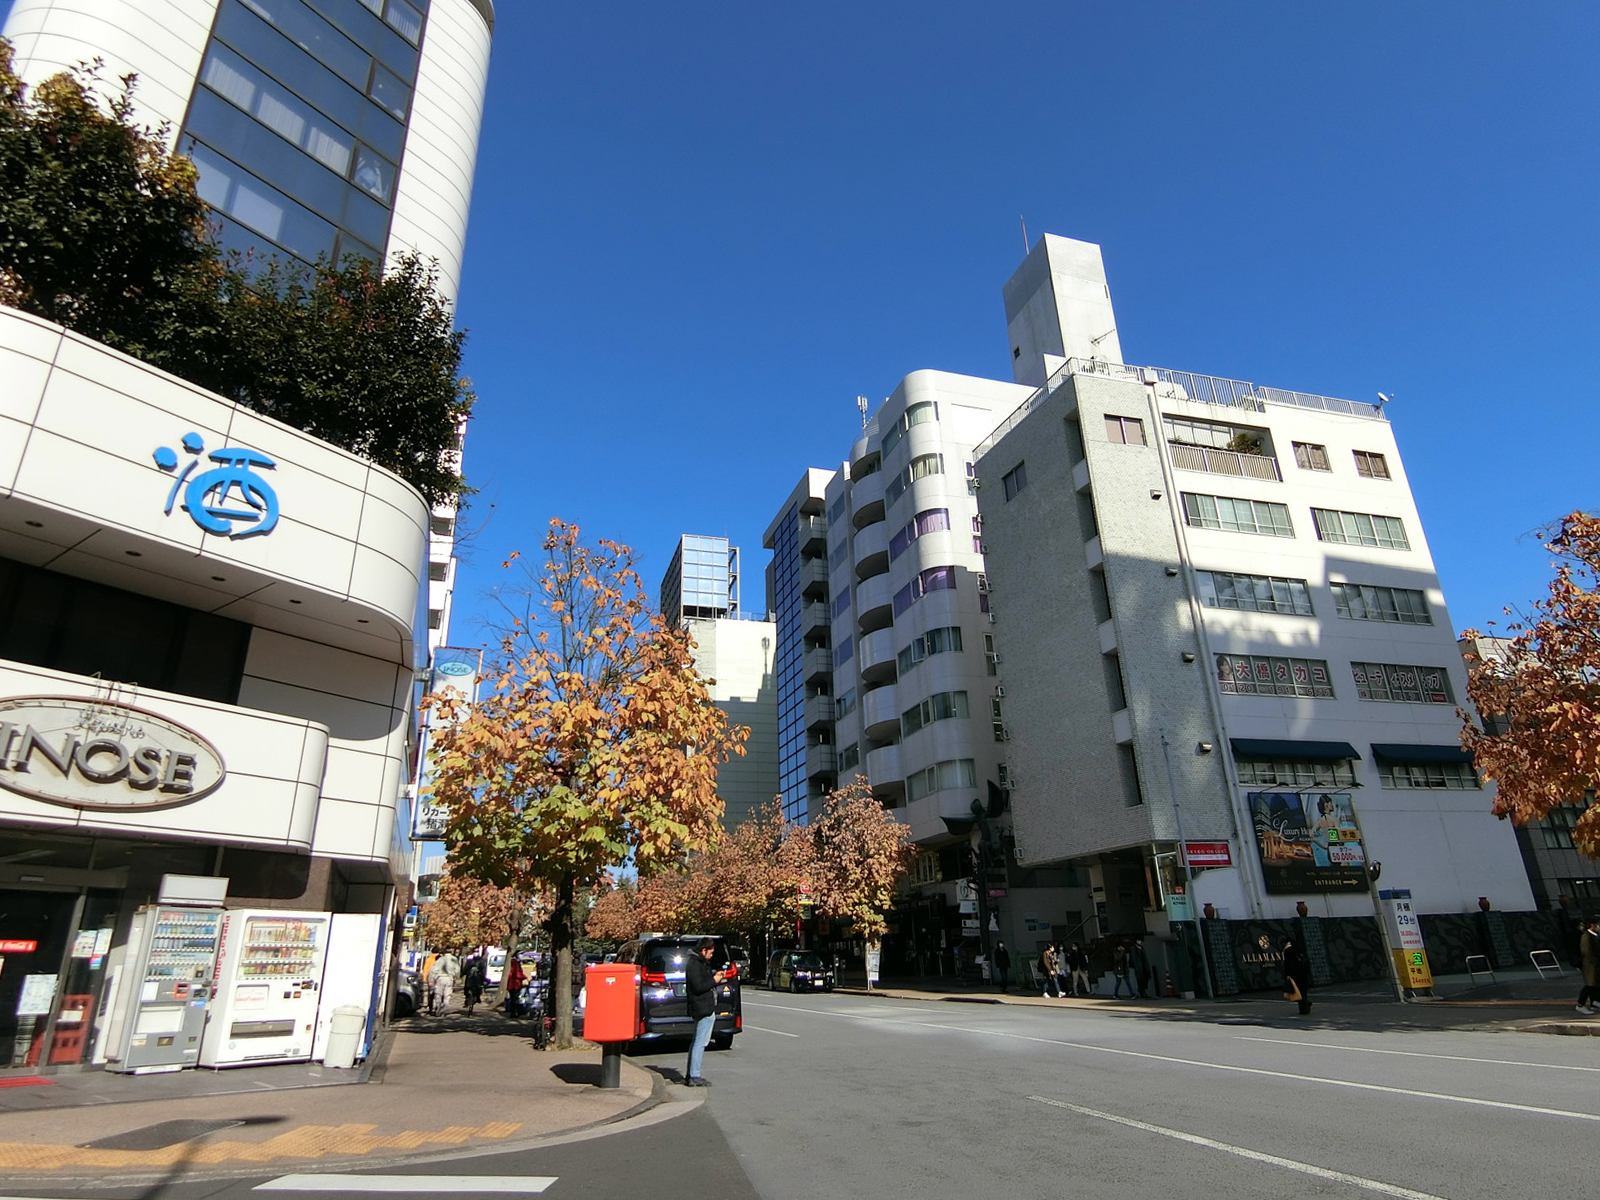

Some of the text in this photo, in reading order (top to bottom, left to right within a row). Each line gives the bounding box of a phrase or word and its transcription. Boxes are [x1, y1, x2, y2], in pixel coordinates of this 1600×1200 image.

[1235, 661, 1327, 682] 大橋タカコ
[1328, 829, 1338, 841] 空
[1397, 915, 1416, 925] 29台
[1413, 953, 1422, 965] 空
